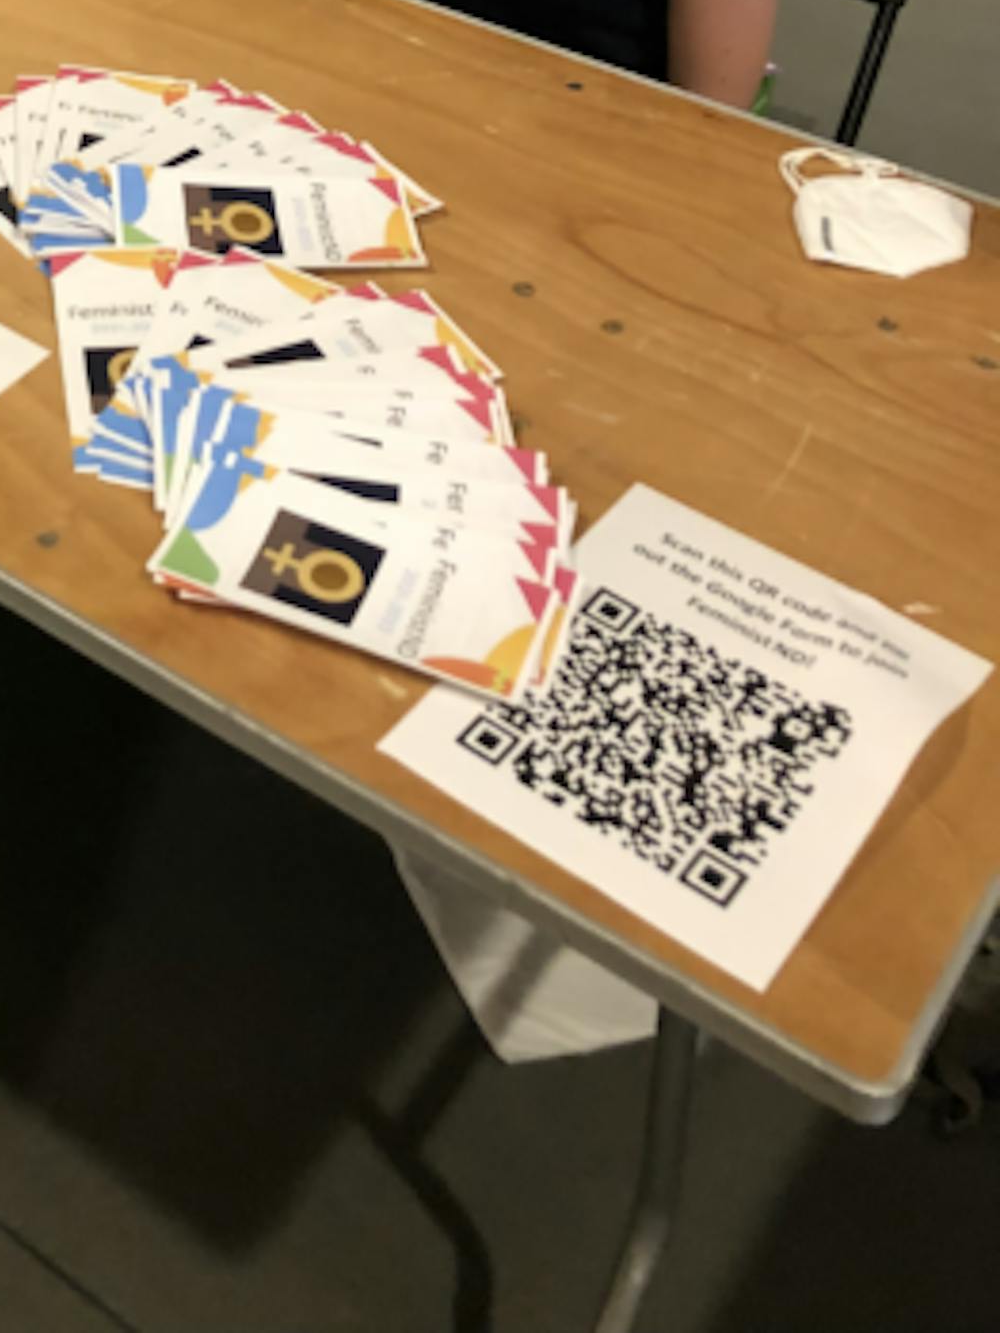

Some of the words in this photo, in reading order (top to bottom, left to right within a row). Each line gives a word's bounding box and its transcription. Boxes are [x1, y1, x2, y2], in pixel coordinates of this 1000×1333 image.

[633, 542, 666, 566] out
[669, 559, 702, 586] the
[705, 576, 775, 624] Google
[779, 617, 833, 650] Form
[660, 531, 703, 562] Scan
[708, 554, 744, 582] this
[748, 576, 780, 602] QR
[782, 592, 833, 623] code
[686, 595, 771, 649] Feminist
